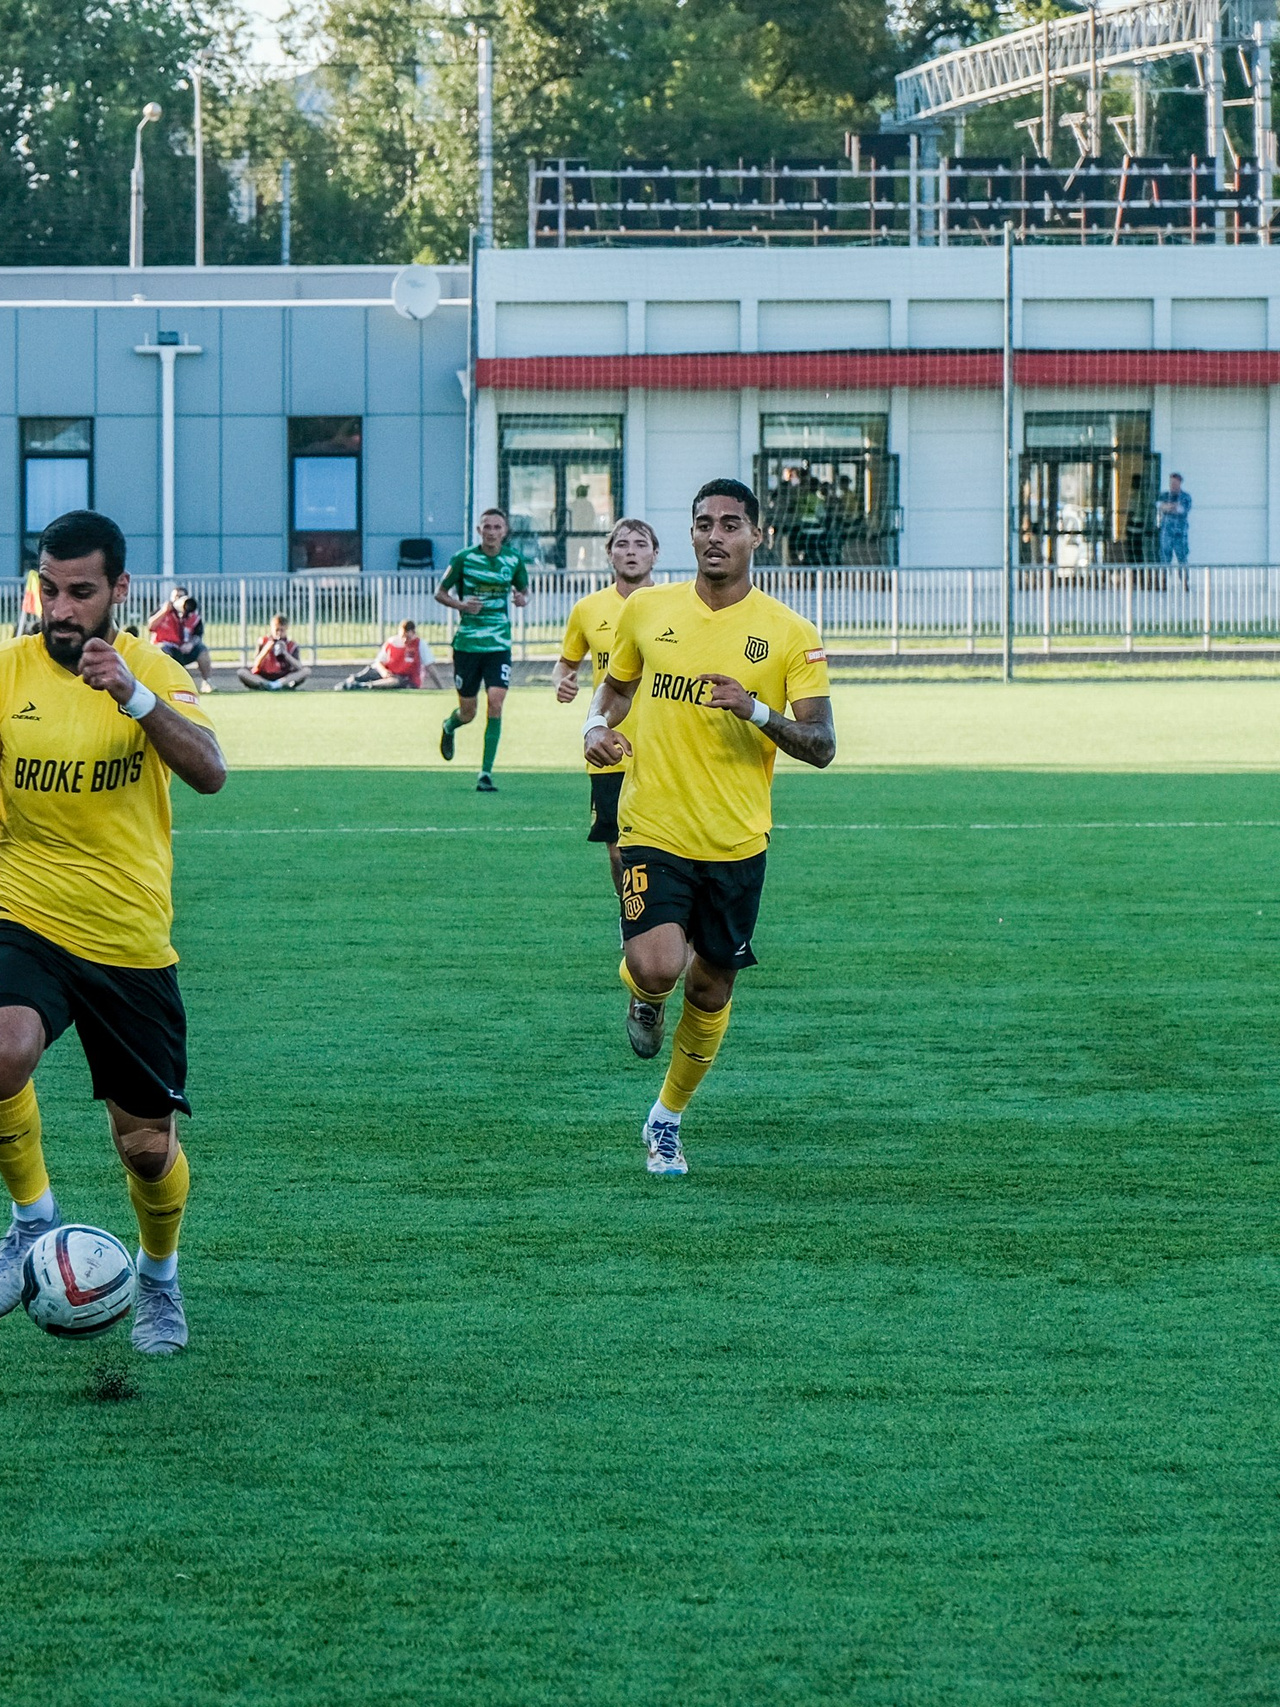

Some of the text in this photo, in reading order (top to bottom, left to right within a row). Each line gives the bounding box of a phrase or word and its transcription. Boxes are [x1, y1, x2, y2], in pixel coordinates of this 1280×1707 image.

[651, 672, 710, 705] BROKE
[11, 713, 41, 721] DEMIX
[14, 751, 144, 793] BROKE BOYS
[622, 864, 648, 900] 26
